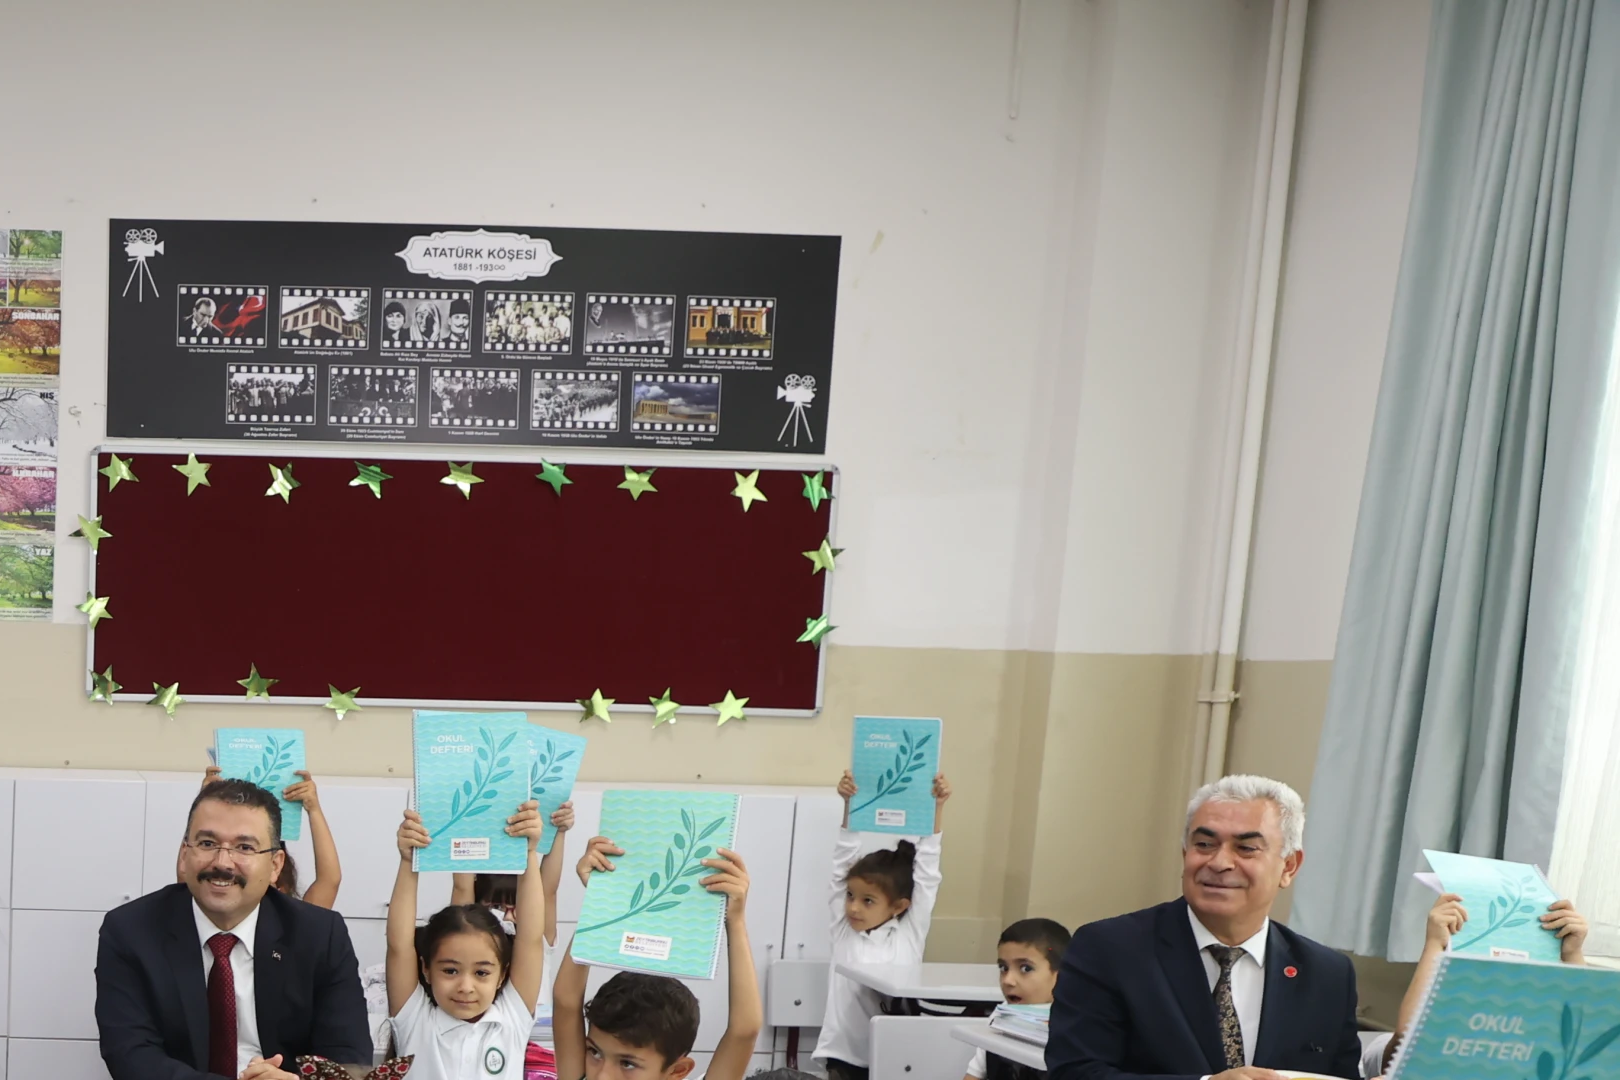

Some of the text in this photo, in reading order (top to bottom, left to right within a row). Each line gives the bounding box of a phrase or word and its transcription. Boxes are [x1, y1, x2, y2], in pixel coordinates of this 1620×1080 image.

[423, 246, 537, 262] ATATÜRK KÖŞESİ
[453, 263, 473, 271] 1881
[11, 311, 60, 320] SONBAHAR
[35, 548, 52, 556] YAZ
[436, 734, 465, 743] OKUL
[430, 743, 474, 755] DEFTERİ
[1468, 1012, 1525, 1035] OKUL
[1441, 1036, 1535, 1062] DEFTERİ
